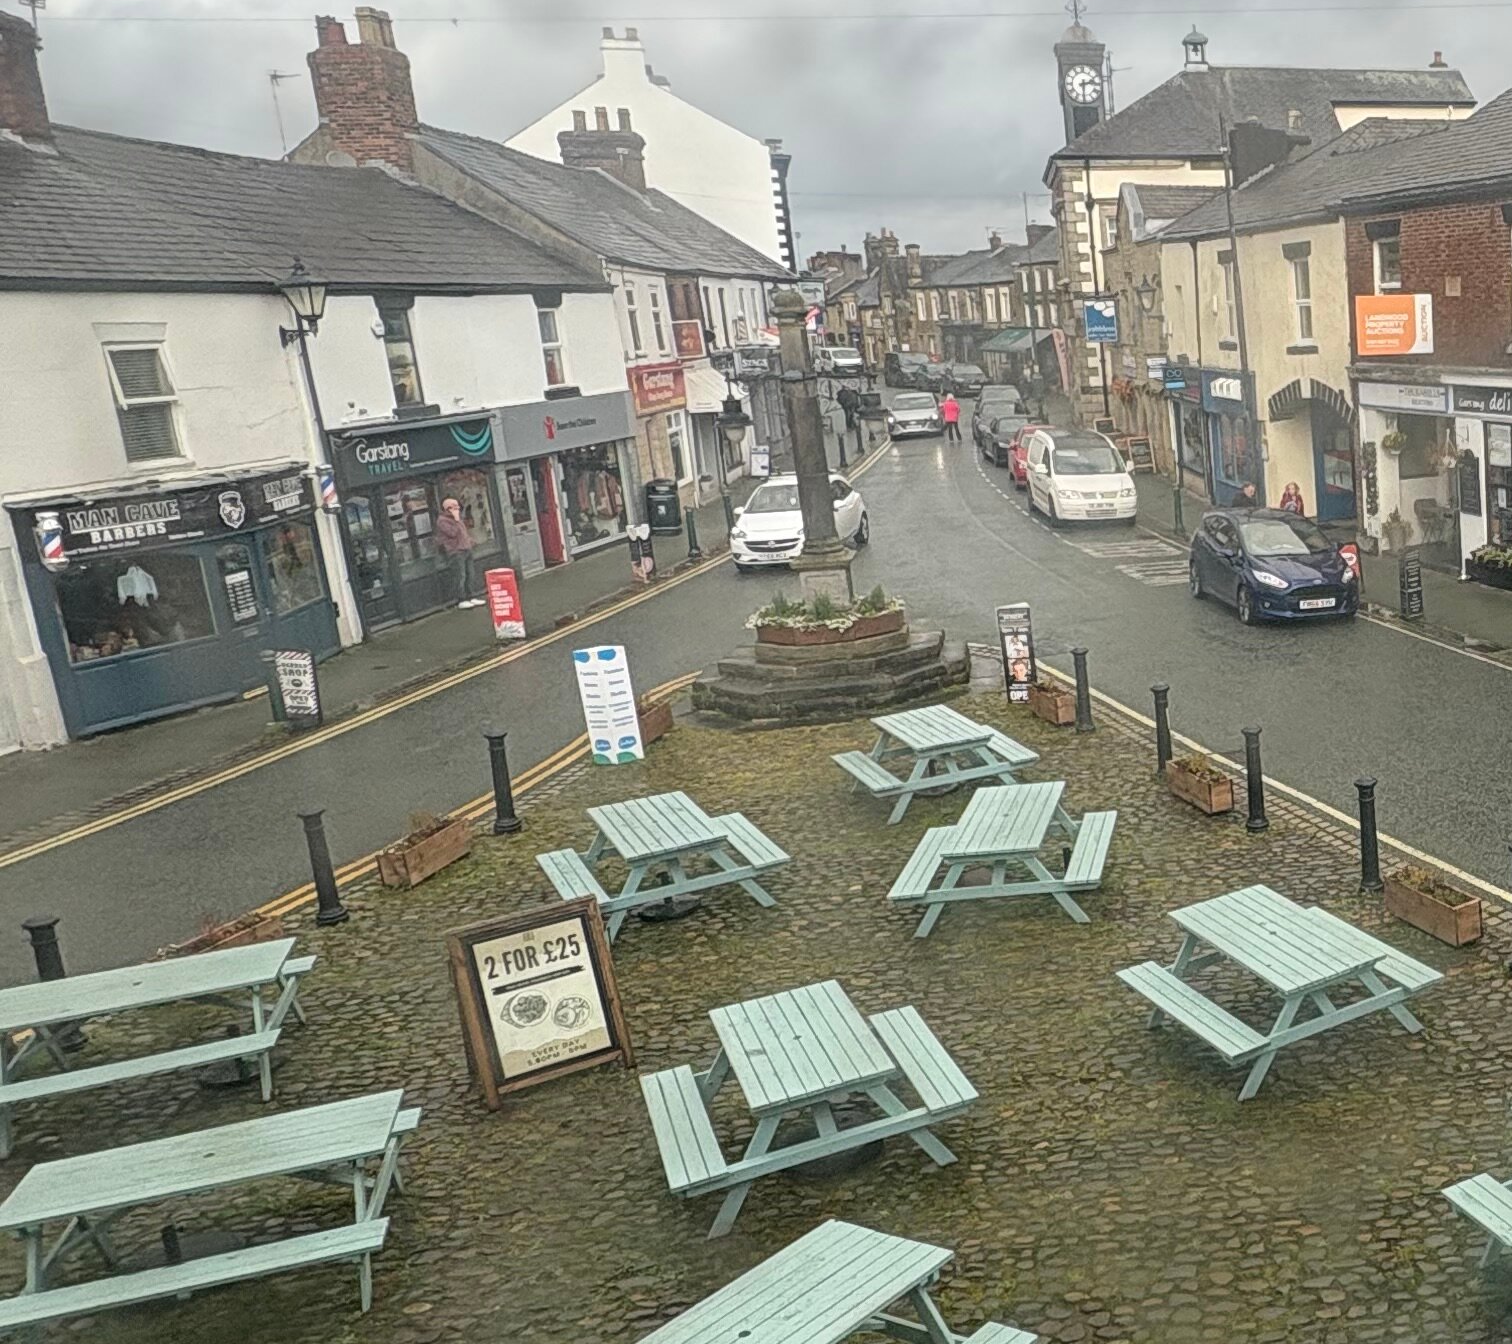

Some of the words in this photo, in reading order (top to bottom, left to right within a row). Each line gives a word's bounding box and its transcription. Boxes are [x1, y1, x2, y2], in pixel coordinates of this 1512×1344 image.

[1489, 392, 1511, 412] deli
[356, 441, 410, 463] Garstang
[368, 461, 403, 475] TRAVEL
[67, 507, 119, 531] MAN
[125, 499, 181, 522] CAVE
[90, 522, 167, 544] BARBERS
[1009, 690, 1029, 700] OPE
[484, 956, 500, 980] 2
[501, 945, 540, 975] FOR
[543, 933, 581, 964] £25
[531, 1044, 559, 1058] EVERY
[562, 1038, 580, 1049] DAY
